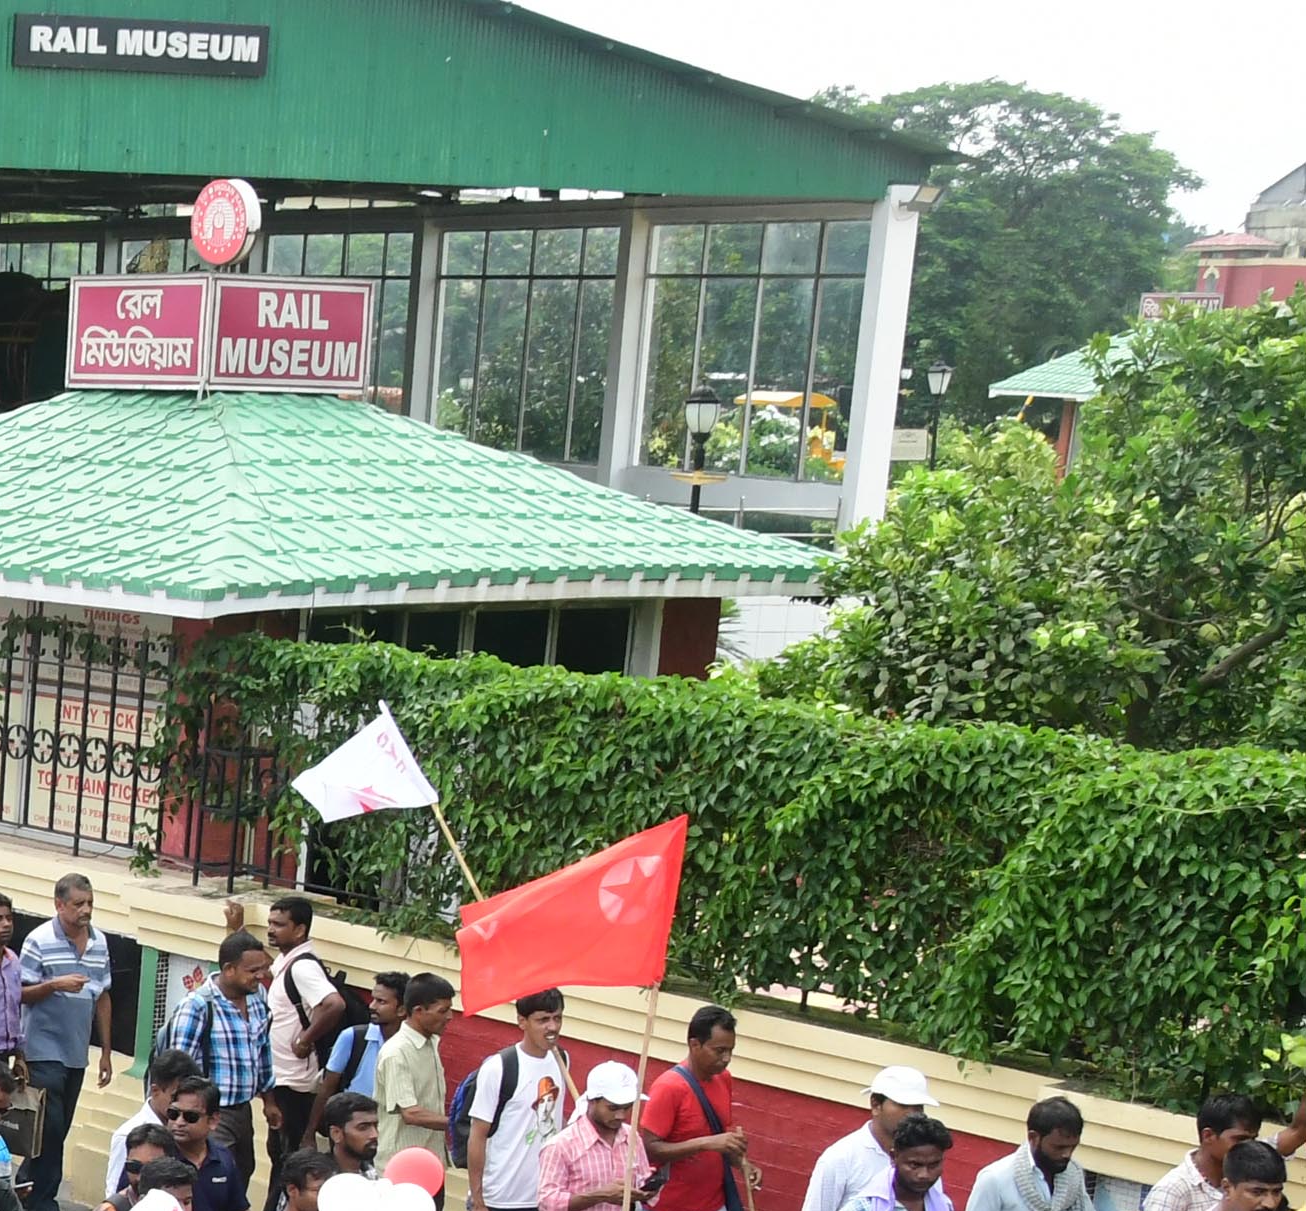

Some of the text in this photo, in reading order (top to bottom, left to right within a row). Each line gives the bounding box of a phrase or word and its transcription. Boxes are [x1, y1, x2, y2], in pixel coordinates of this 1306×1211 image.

[29, 26, 261, 64] RAIL MUSEUM
[116, 287, 162, 320] রেল
[257, 291, 329, 330] RAIL
[219, 337, 357, 379] MUSEUM
